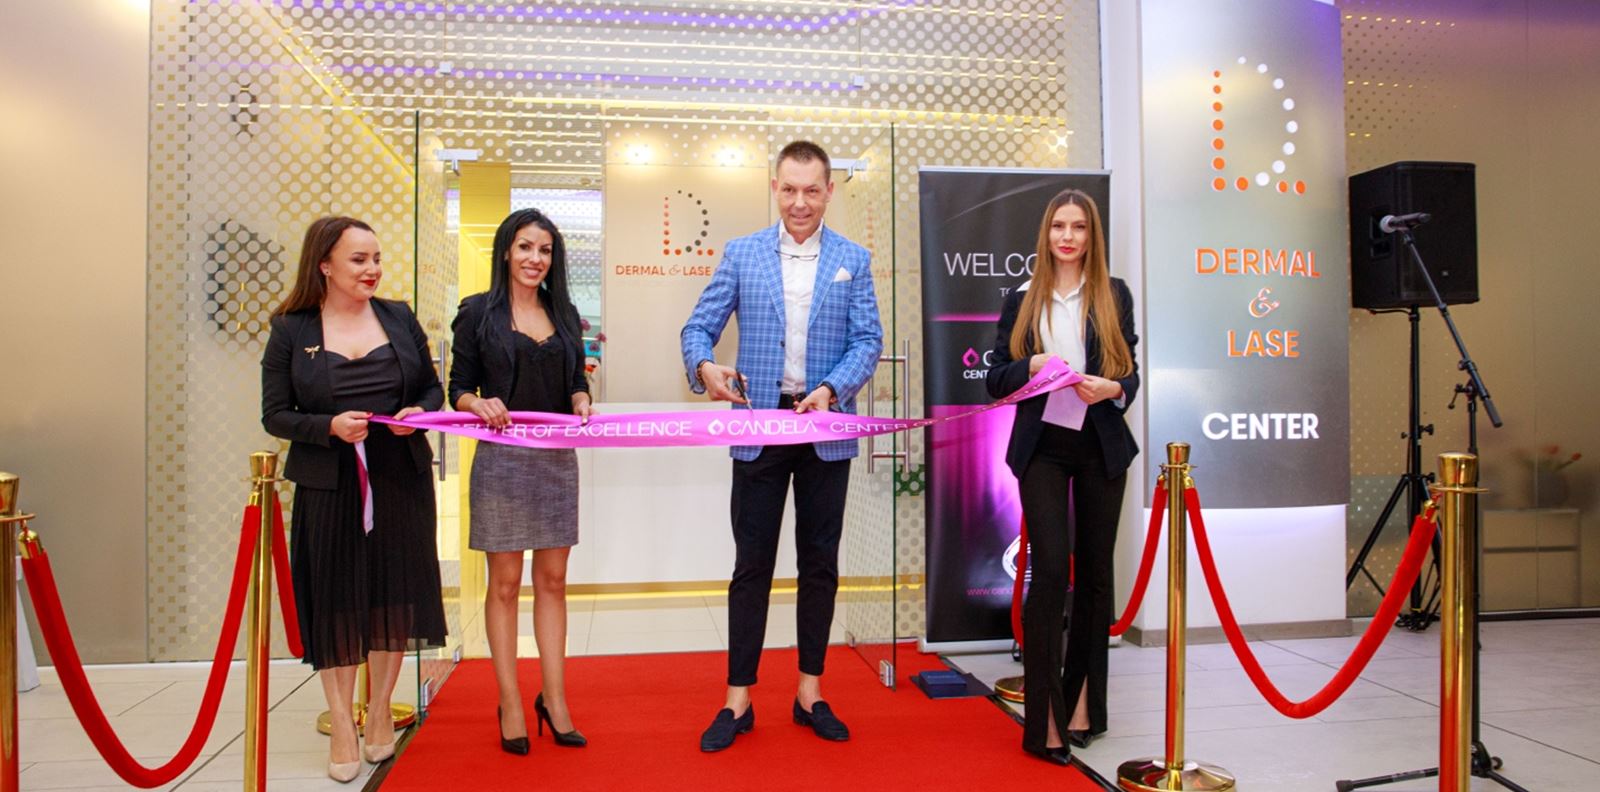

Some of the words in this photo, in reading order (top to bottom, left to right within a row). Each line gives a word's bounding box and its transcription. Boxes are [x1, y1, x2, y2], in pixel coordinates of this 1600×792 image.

[615, 265, 666, 276] DERMAL
[668, 264, 681, 276] &
[683, 266, 711, 276] LASE
[1195, 248, 1321, 278] DERMAL
[1248, 287, 1280, 318] &
[1227, 329, 1300, 358] LASE
[452, 423, 527, 438] NTER
[532, 424, 560, 438] OF
[564, 421, 692, 437] EXCELLENCE
[727, 420, 818, 436] CANDELA
[1202, 412, 1320, 440] CENTER
